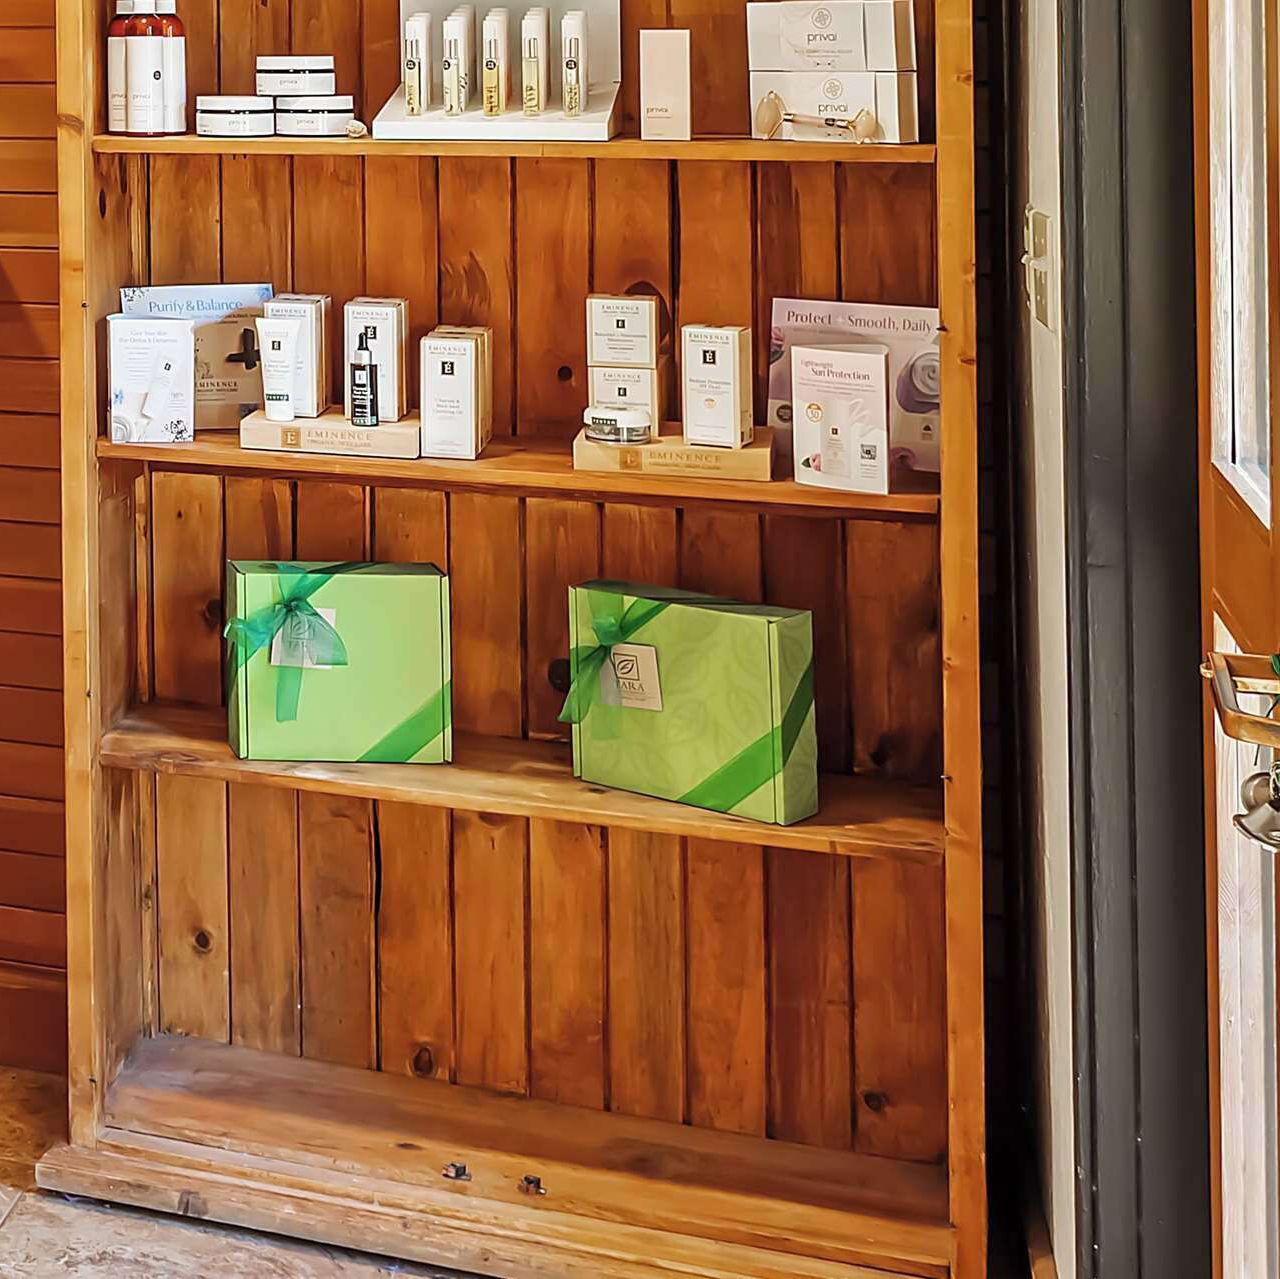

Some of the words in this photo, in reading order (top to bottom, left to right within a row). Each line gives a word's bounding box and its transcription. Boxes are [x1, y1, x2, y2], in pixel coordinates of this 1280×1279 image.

[807, 33, 838, 45] privai
[818, 103, 849, 115] privai
[149, 299, 184, 314] Purify
[186, 300, 195, 311] &
[196, 298, 243, 311] Balance
[787, 311, 832, 325] Protect
[848, 315, 899, 332] Smooth,
[902, 318, 932, 334] Daily
[811, 368, 825, 376] Sun
[827, 368, 870, 380] Protection
